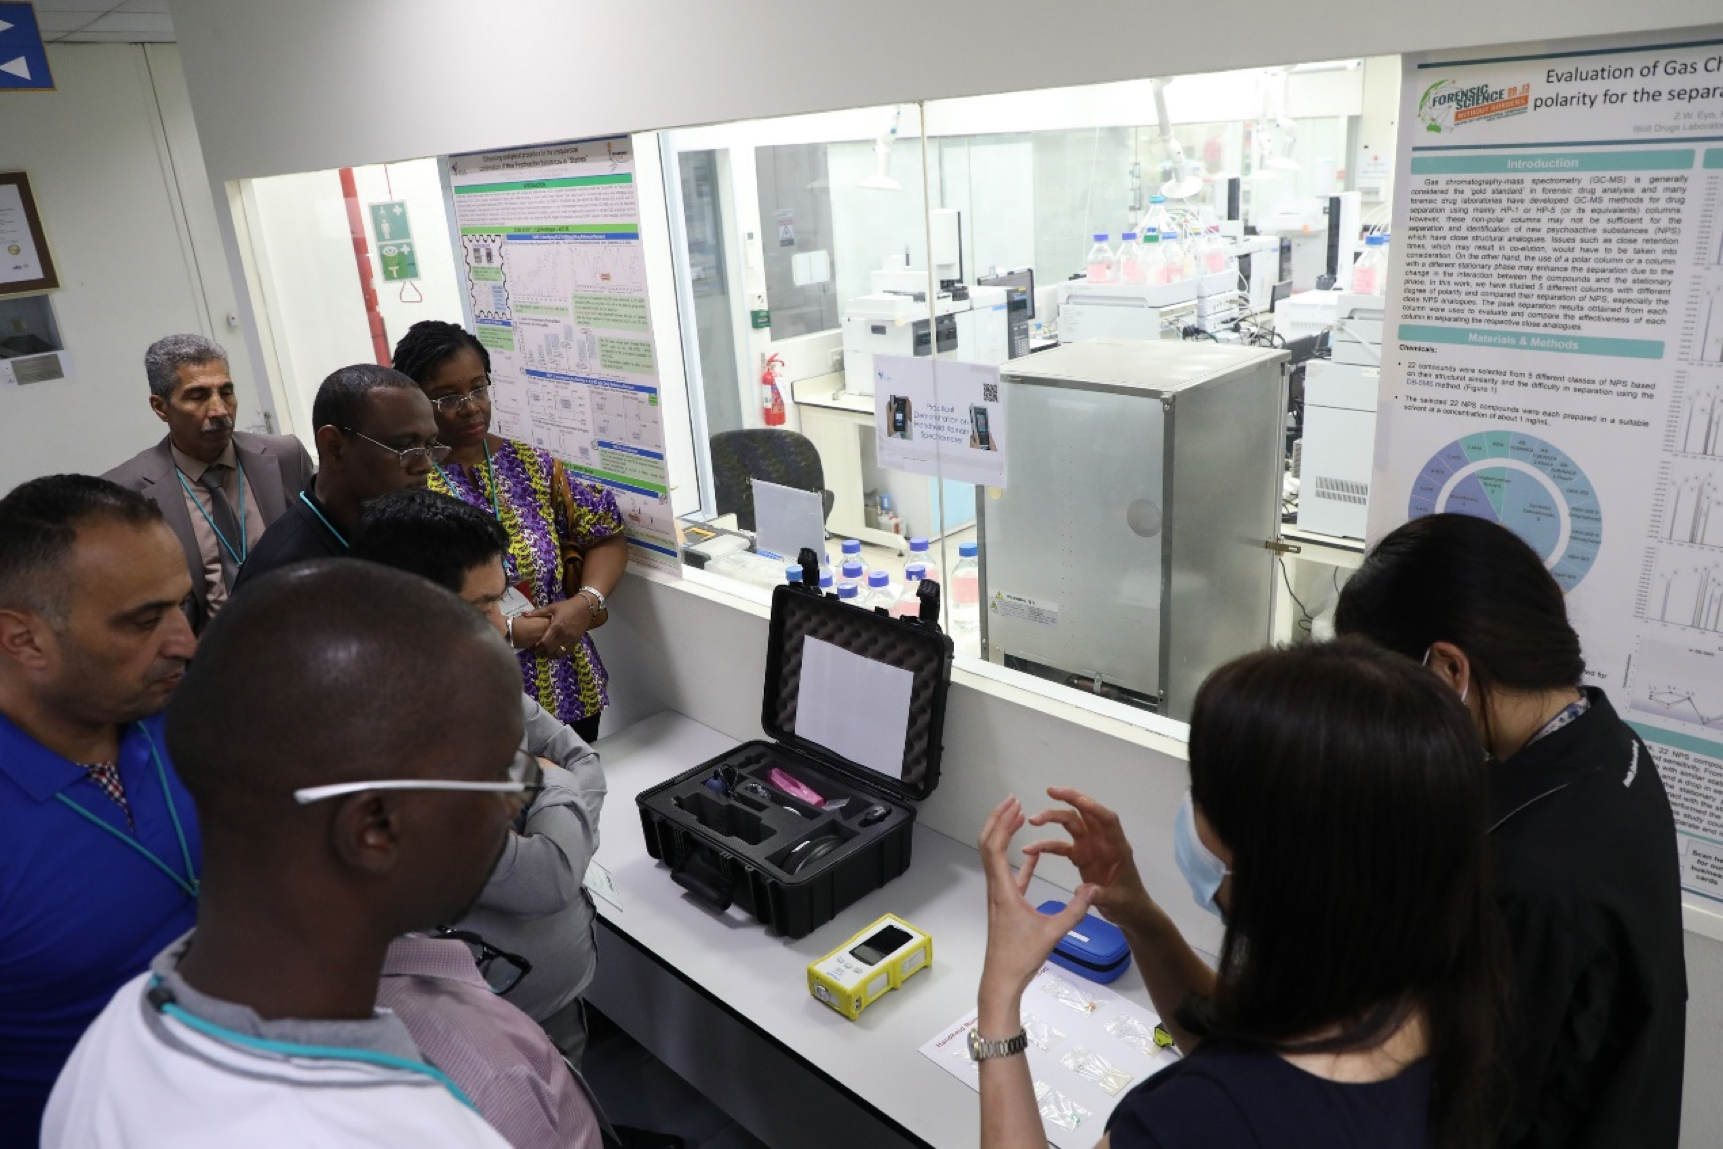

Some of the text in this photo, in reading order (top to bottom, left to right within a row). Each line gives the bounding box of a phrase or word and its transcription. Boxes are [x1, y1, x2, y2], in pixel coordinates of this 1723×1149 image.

[1546, 65, 1634, 84] Evaluation
[1640, 60, 1660, 77] of
[1664, 60, 1698, 76] Gas
[1432, 84, 1488, 107] FORENSIC
[1456, 88, 1506, 110] SCIENCE
[1533, 92, 1598, 110] polarity
[1603, 89, 1628, 104] for
[1633, 88, 1662, 103] the
[1458, 106, 1488, 118] WITHOUT
[1490, 98, 1526, 112] BORDERS
[1654, 124, 1680, 133] Drugs
[1507, 158, 1578, 170] Introduction
[1589, 177, 1627, 185] (GC-MS)
[1648, 176, 1689, 185] generally
[1578, 188, 1596, 196] drug
[1601, 187, 1636, 196] analysis
[1441, 197, 1458, 206] drug
[1529, 197, 1569, 206] developed
[1665, 197, 1686, 205] drug
[1409, 207, 1446, 215] separation
[1449, 207, 1469, 215] using
[1560, 207, 1571, 215] (or
[1590, 207, 1640, 215] equivalents)
[1408, 225, 1444, 234] separation
[1546, 226, 1597, 234] psychoactive
[1654, 227, 1681, 235] (NPS)
[1468, 332, 1579, 350] Materials & Methods
[1399, 344, 1437, 353] Chemicals:
[1478, 368, 1507, 376] selected
[1535, 373, 1565, 382] different
[1567, 376, 1596, 384] classes
[1630, 381, 1656, 389] based
[1434, 373, 1466, 381] structural
[1531, 381, 1560, 392] difficulty
[1573, 387, 1614, 395] separation
[1616, 390, 1638, 399] using
[1672, 750, 1689, 760] NPS
[1680, 770, 1705, 780] similar
[1685, 780, 1701, 789] drop
[1680, 787, 1716, 802] stationary
[1684, 813, 1704, 823] study
[1692, 850, 1712, 860] Scan
[1696, 875, 1718, 885] cards
[936, 1025, 966, 1048] Handheld
